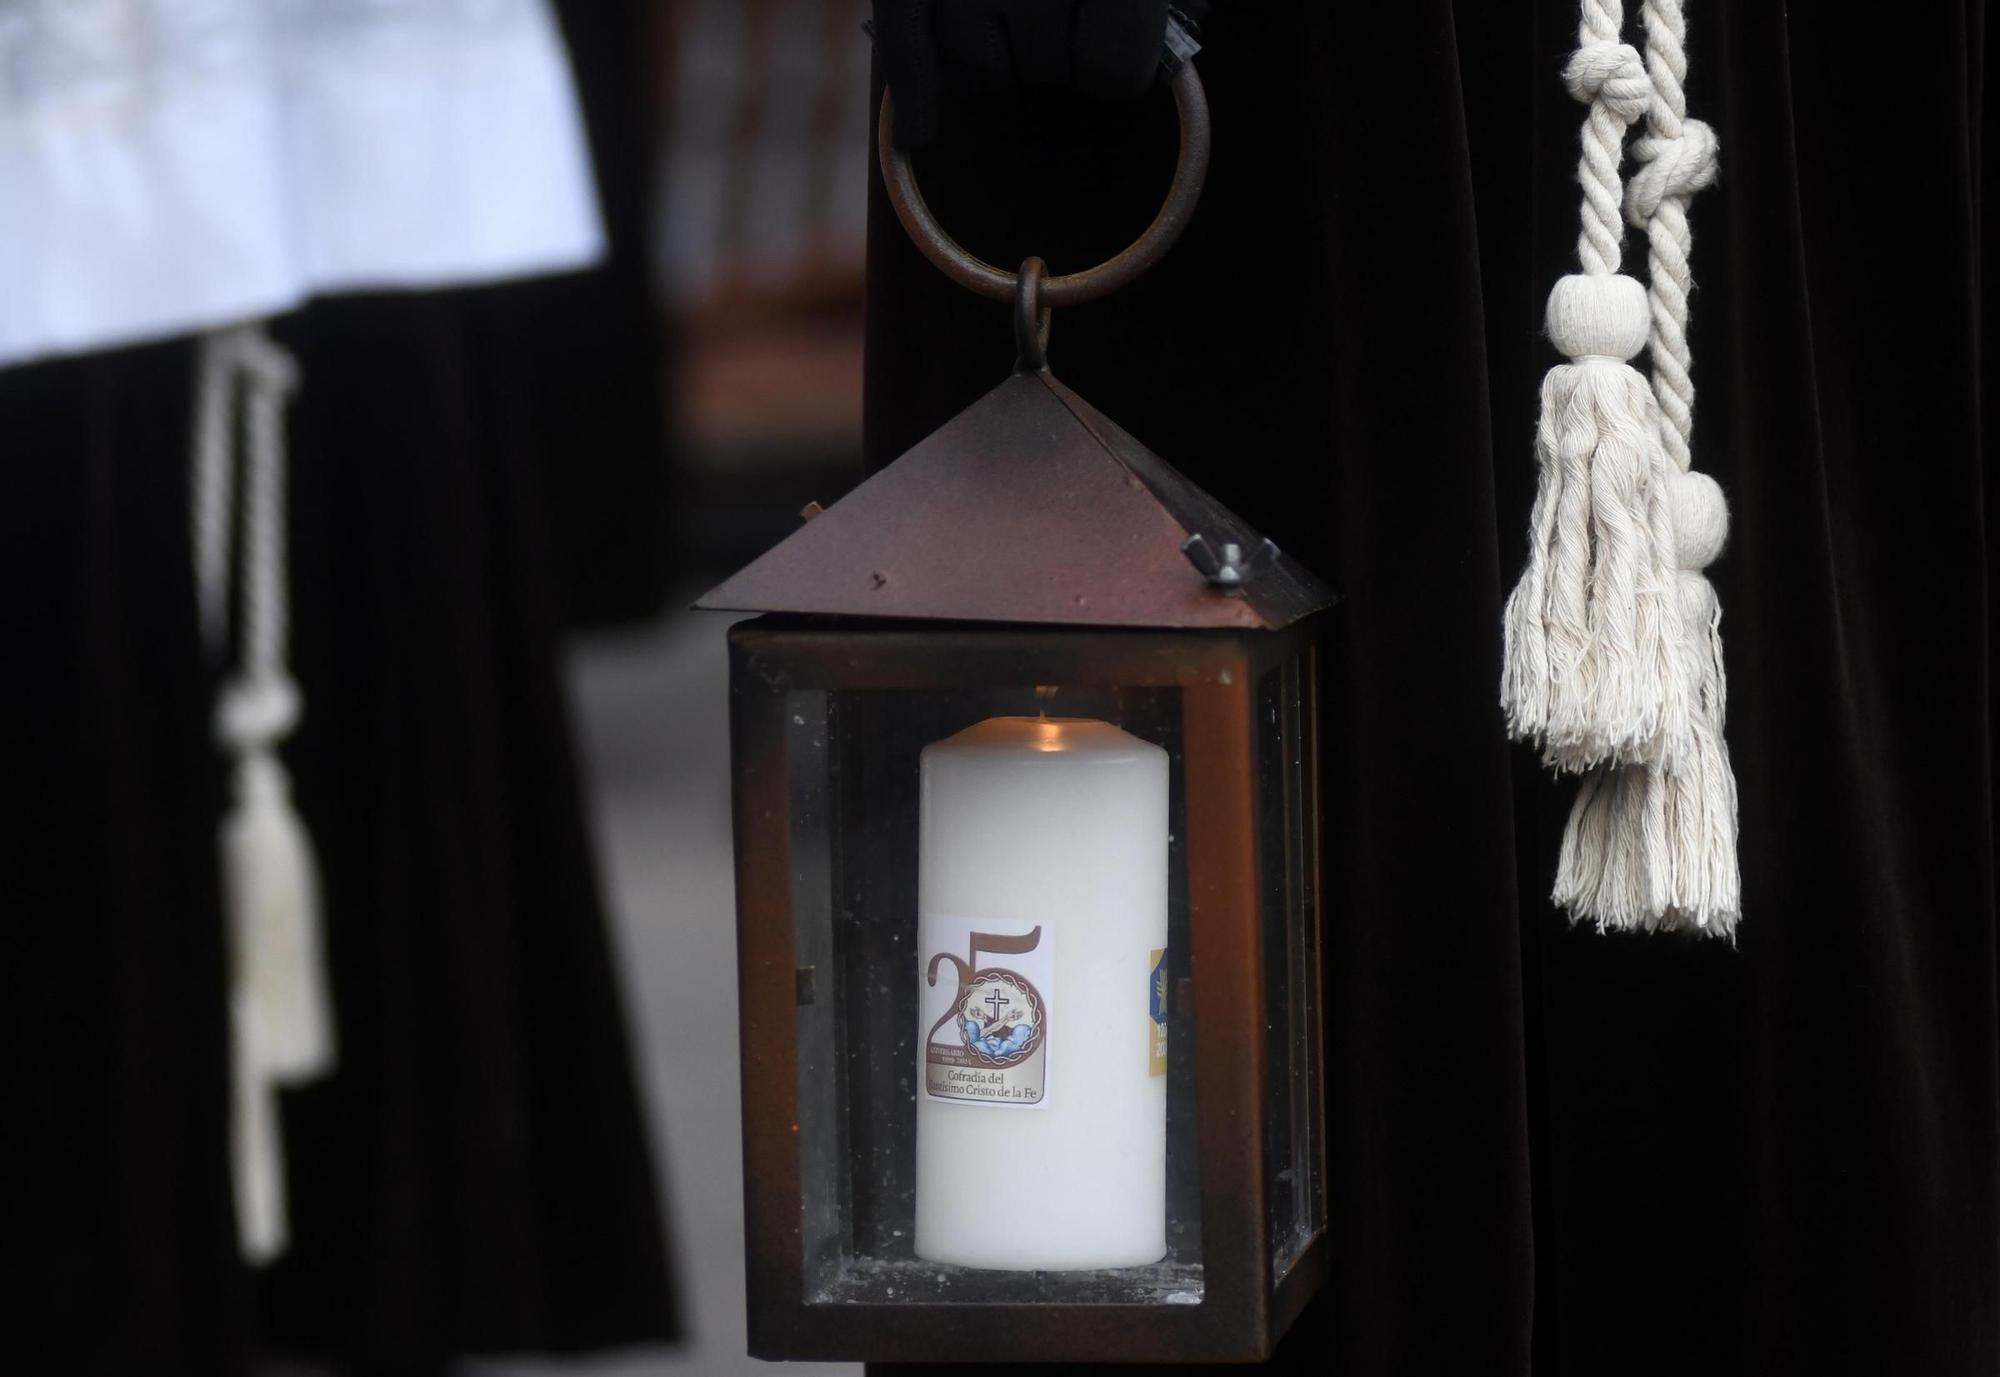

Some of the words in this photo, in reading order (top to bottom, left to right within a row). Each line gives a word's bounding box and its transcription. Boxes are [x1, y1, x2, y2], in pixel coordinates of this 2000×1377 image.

[928, 926, 1046, 1069] 25
[947, 1070, 986, 1083] Cofradía
[988, 1072, 1004, 1084] del
[965, 1084, 996, 1097] Cristo
[997, 1086, 1011, 1097] de
[1012, 1086, 1022, 1098] la
[1025, 1087, 1037, 1098] Fe
